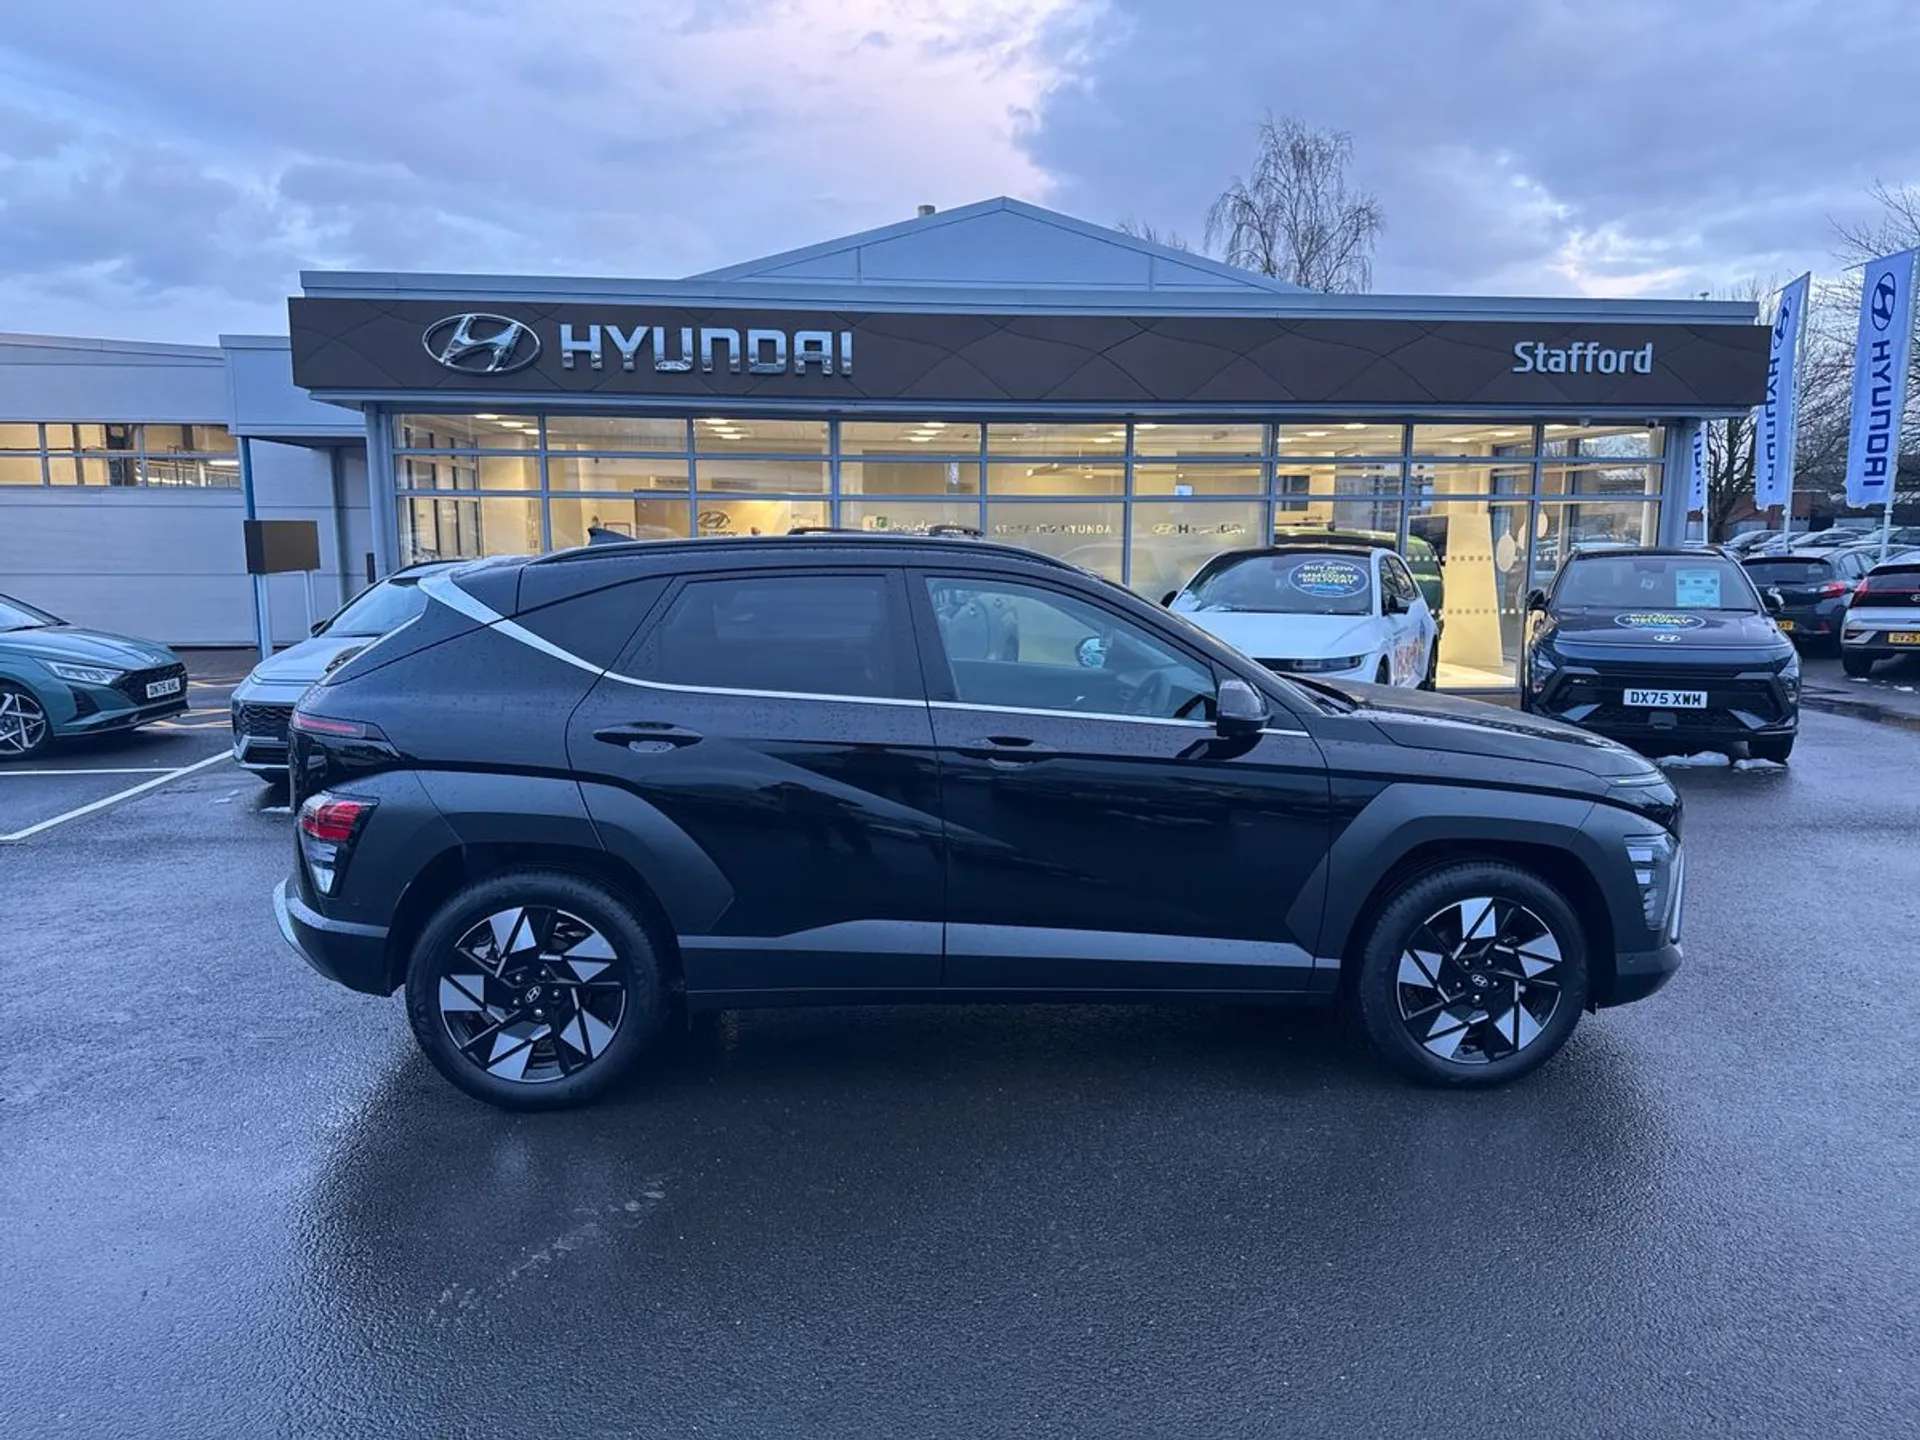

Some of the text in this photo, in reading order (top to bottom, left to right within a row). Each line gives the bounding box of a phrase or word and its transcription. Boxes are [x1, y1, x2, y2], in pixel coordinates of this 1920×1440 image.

[560, 324, 853, 375] HYUNDAI
[1512, 341, 1654, 374] Stafford
[1765, 357, 1780, 490] HYUND
[1863, 339, 1892, 487] HYUNDAI
[1630, 691, 1702, 706] DX75 XWM
